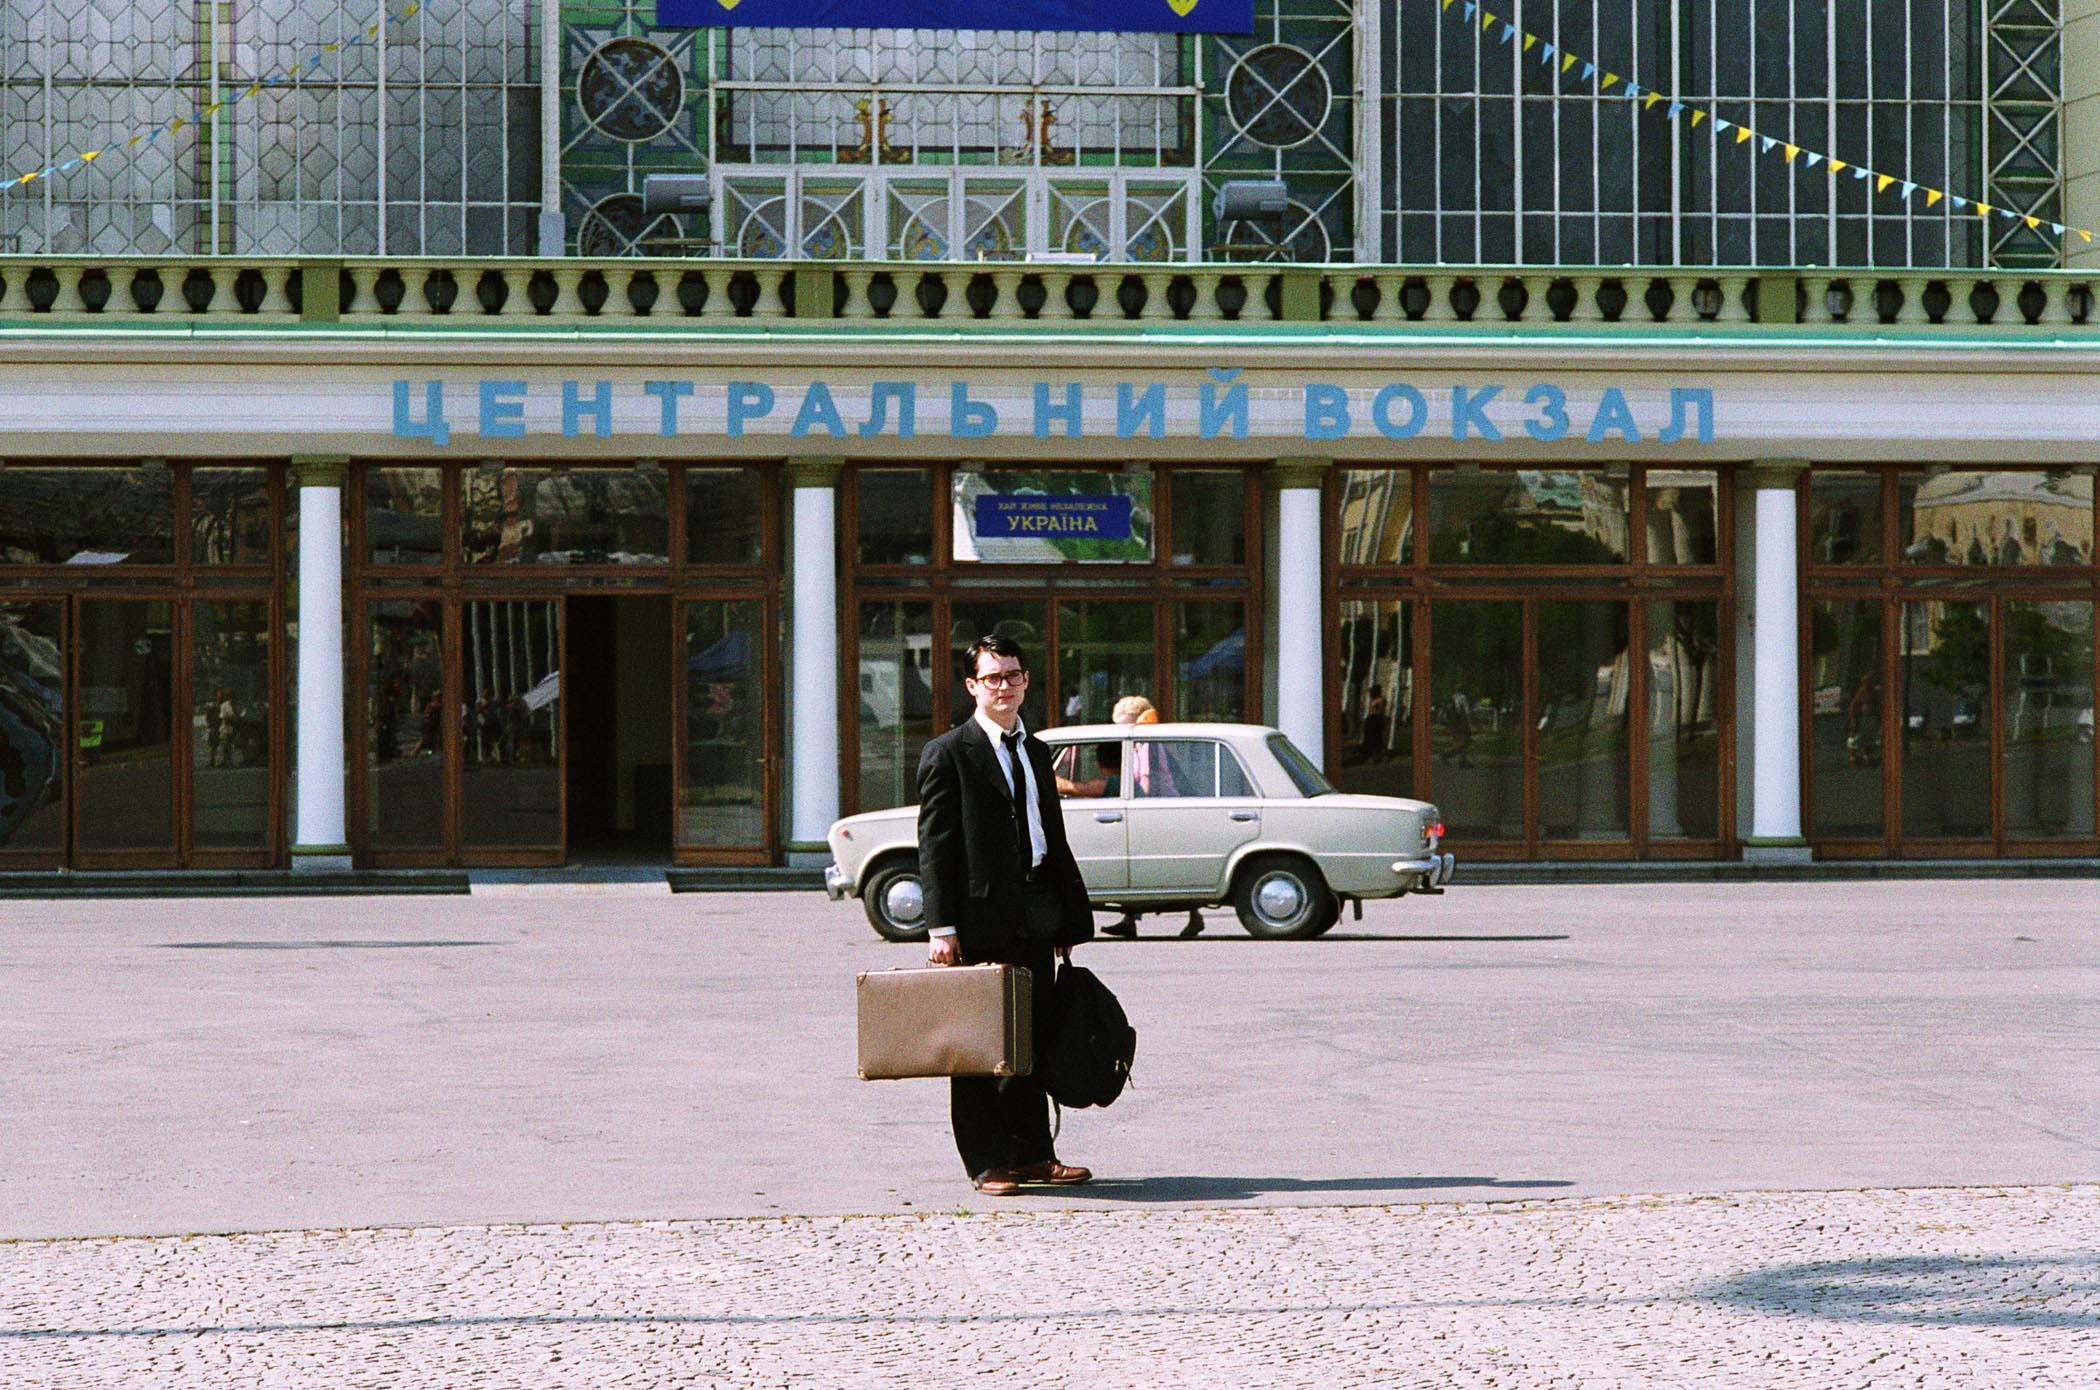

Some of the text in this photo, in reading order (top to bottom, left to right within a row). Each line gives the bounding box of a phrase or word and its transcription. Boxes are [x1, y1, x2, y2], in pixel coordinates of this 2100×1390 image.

[393, 368, 1714, 445] ЦЕНТРАЛЬНИЙ ВОКЗАЛ
[1007, 513, 1099, 531] УКРАЇНА
